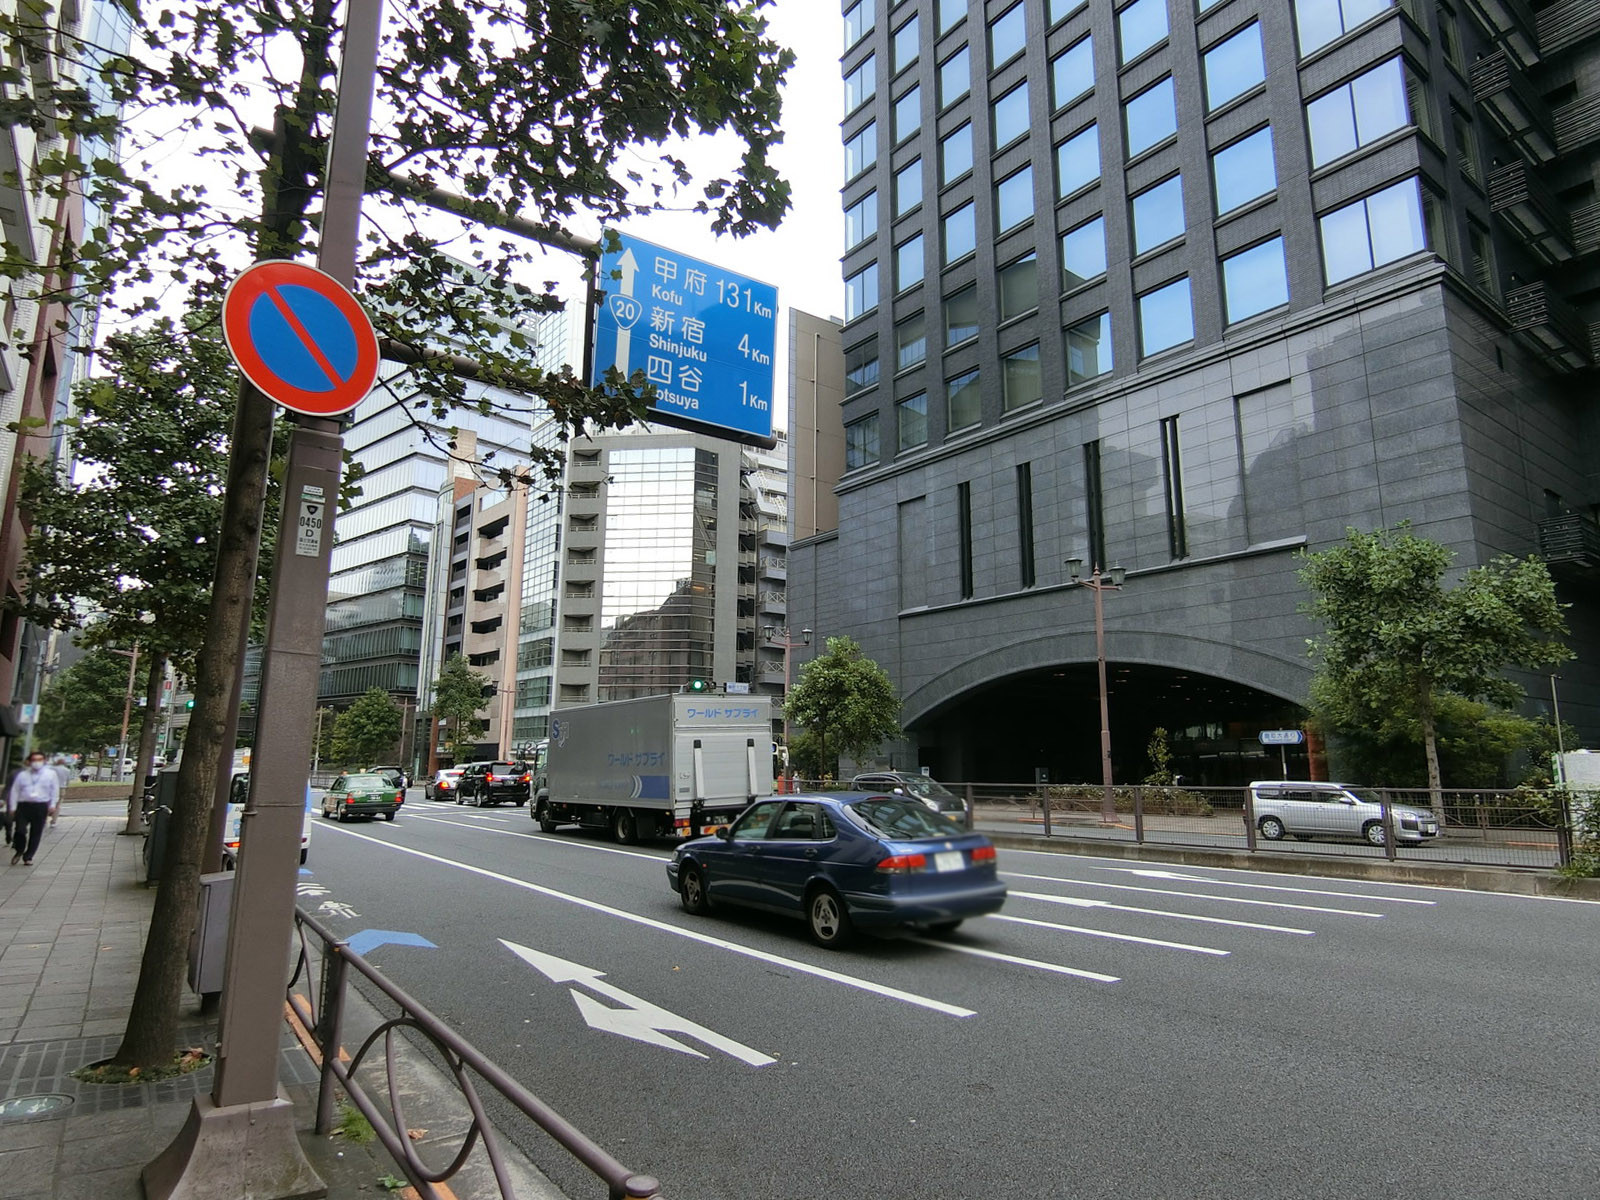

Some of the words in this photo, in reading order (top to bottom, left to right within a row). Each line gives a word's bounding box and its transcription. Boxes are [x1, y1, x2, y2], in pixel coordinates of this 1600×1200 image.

[654, 256, 707, 296] 甲府
[652, 284, 683, 306] Kofu
[615, 301, 635, 320] 20
[650, 305, 706, 345] 新宿
[649, 334, 707, 362] Shinjuku
[647, 355, 703, 393] 四谷
[649, 385, 699, 410] otsuya
[300, 516, 322, 529] 0450
[305, 529, 314, 537] D
[687, 708, 722, 719] ワールド
